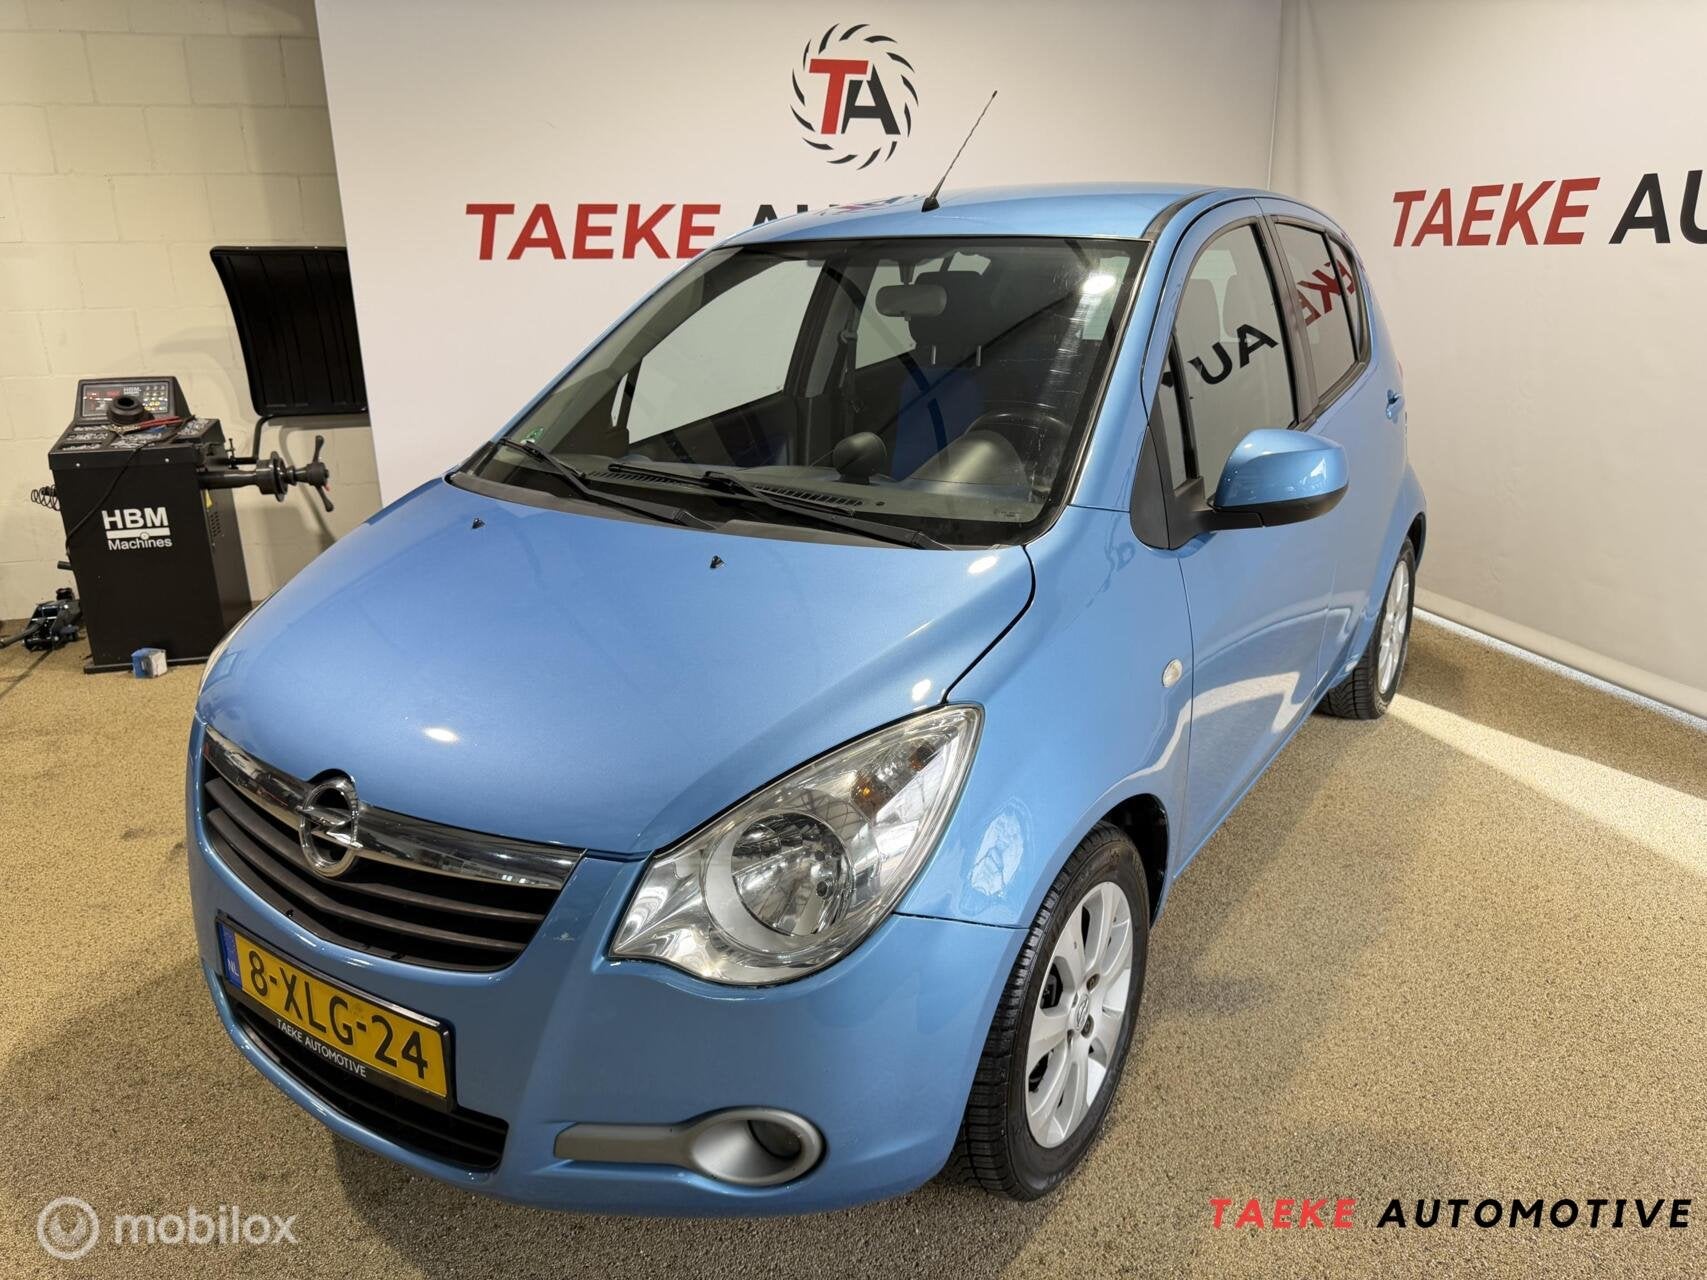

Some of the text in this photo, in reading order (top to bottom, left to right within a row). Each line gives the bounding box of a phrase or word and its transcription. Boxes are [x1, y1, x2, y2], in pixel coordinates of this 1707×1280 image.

[808, 58, 901, 135] TA
[465, 203, 721, 260] TAEKE
[1392, 177, 1601, 246] TAEKE
[101, 506, 169, 530] HBM
[107, 537, 173, 551] Machines
[227, 959, 239, 978] NL
[248, 949, 429, 1080] 8-XLG-24
[276, 1018, 367, 1078] TAEKE AUTOMOTIVE
